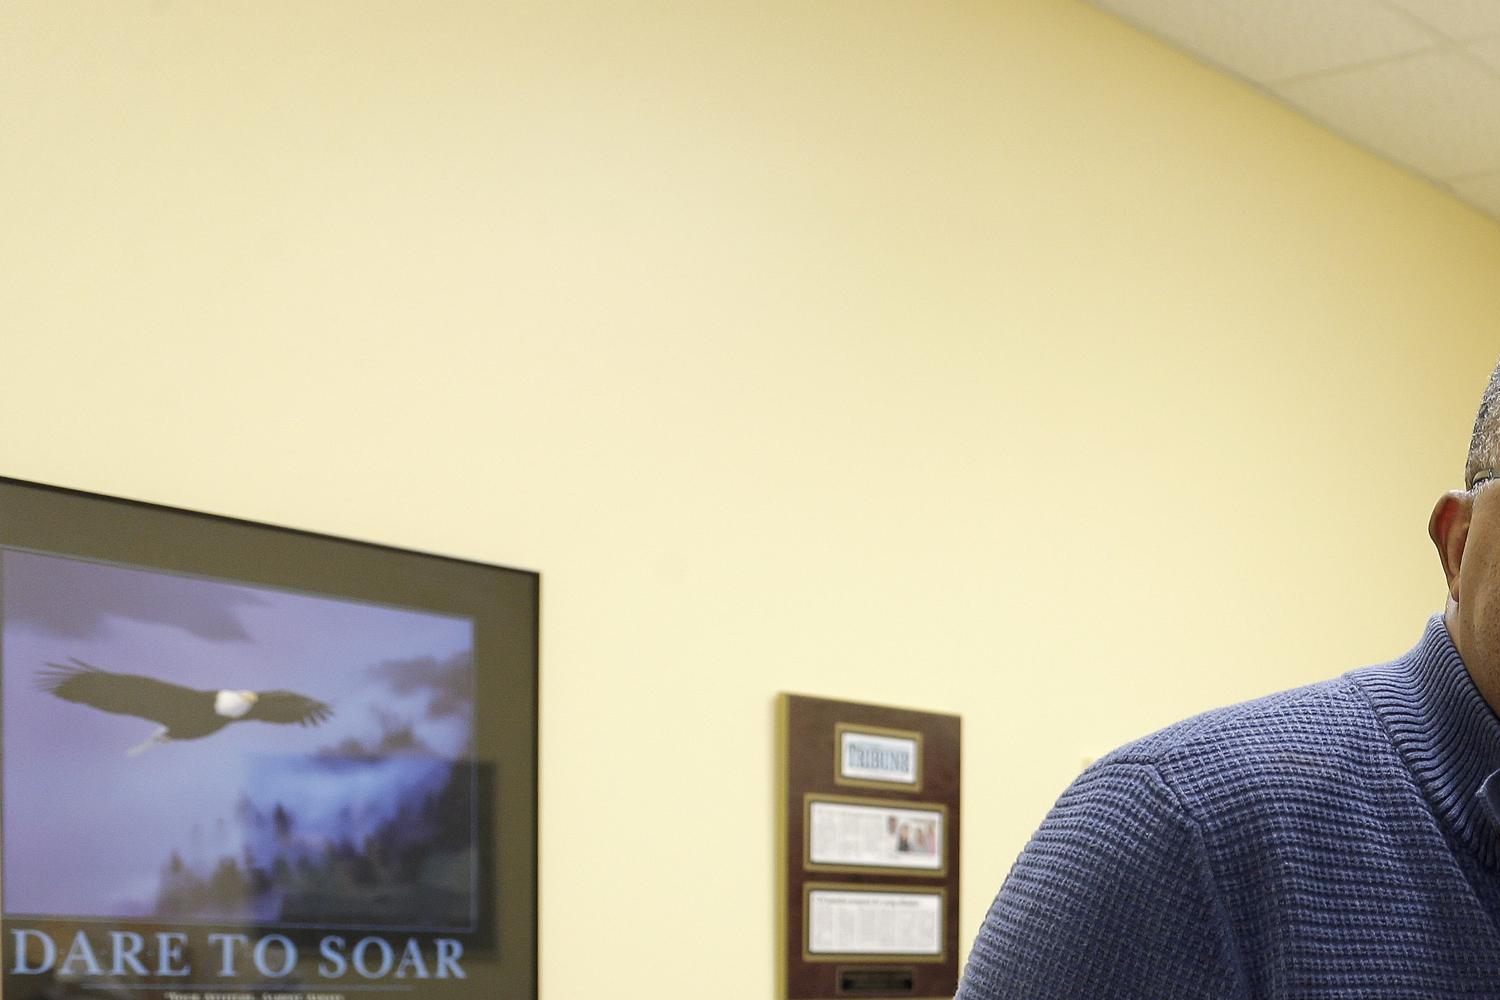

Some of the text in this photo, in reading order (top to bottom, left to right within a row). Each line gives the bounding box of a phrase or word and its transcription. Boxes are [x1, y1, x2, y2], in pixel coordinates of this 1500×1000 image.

[11, 927, 467, 980] DARE TO SOAR
